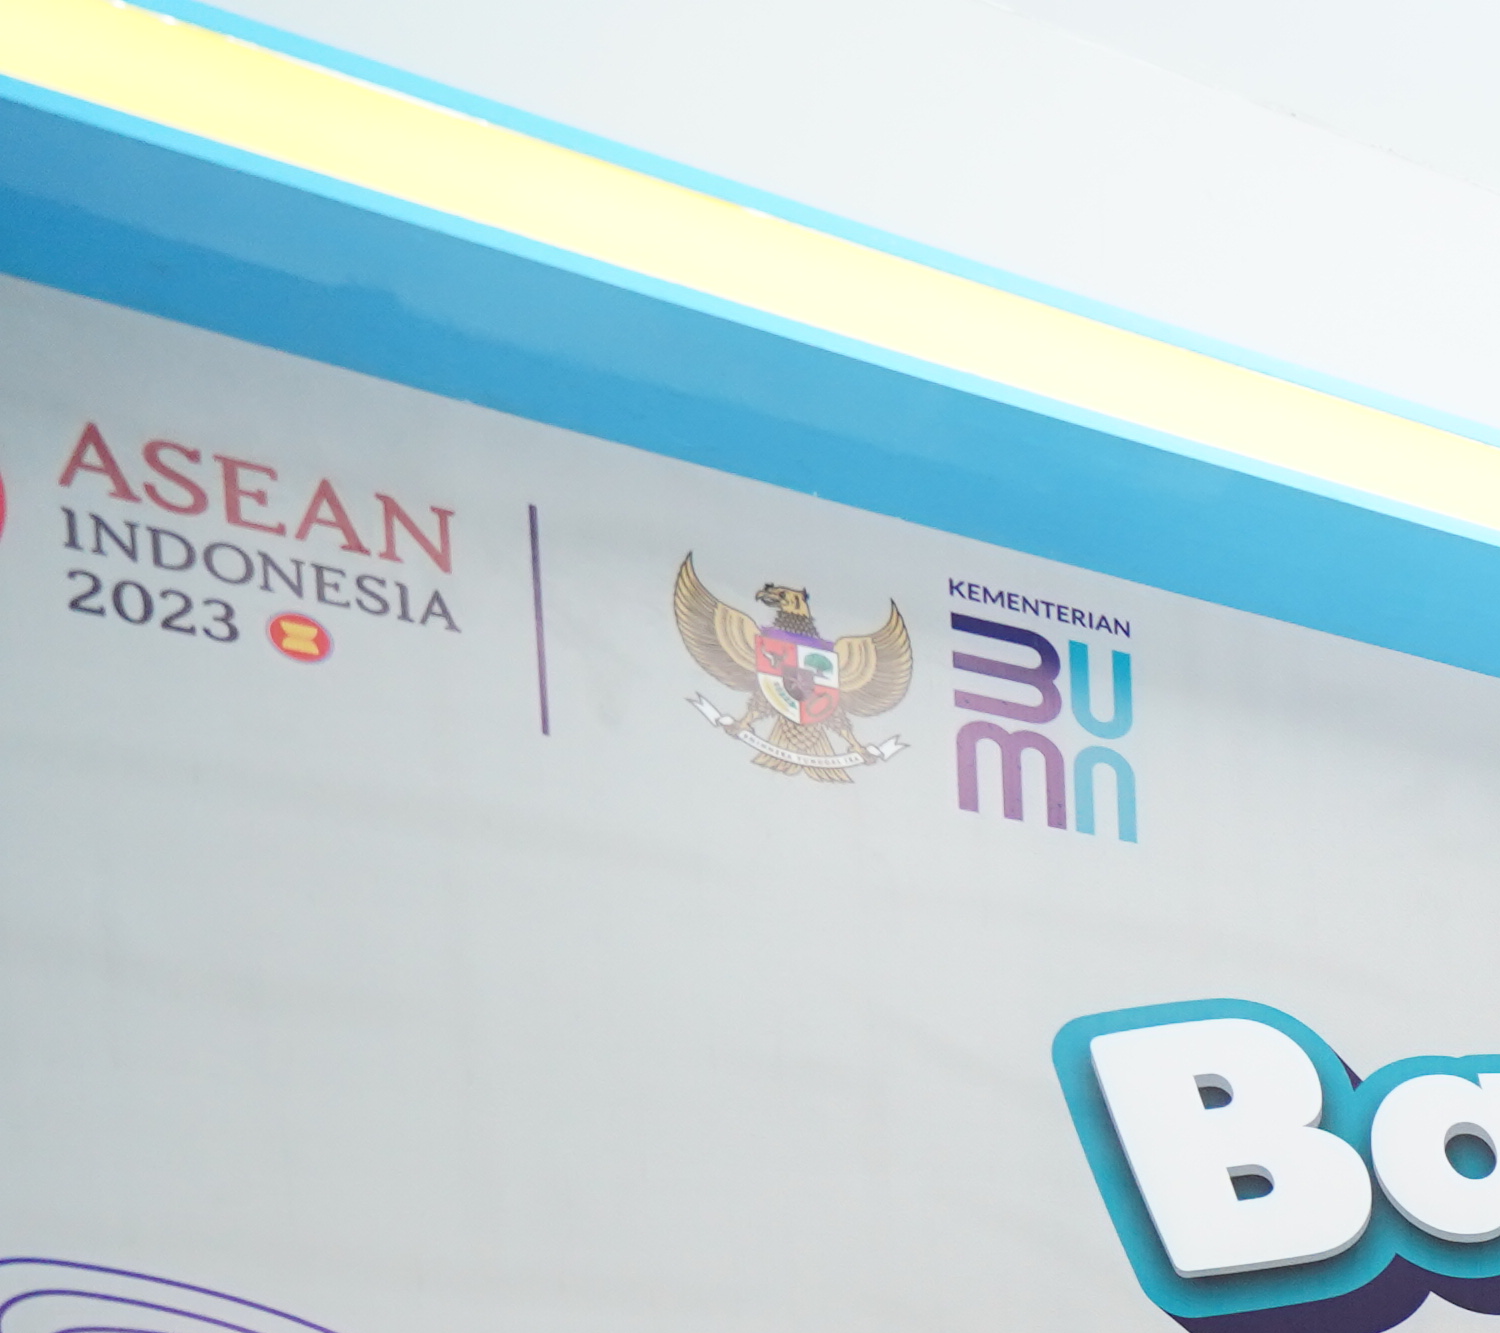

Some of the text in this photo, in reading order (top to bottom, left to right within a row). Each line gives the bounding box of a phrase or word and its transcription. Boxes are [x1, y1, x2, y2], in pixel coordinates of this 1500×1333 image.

[58, 422, 456, 574] ASEAN
[60, 507, 462, 634] INDONESIA
[66, 570, 241, 645] 2023
[948, 577, 1132, 639] KEMENTERIAN
